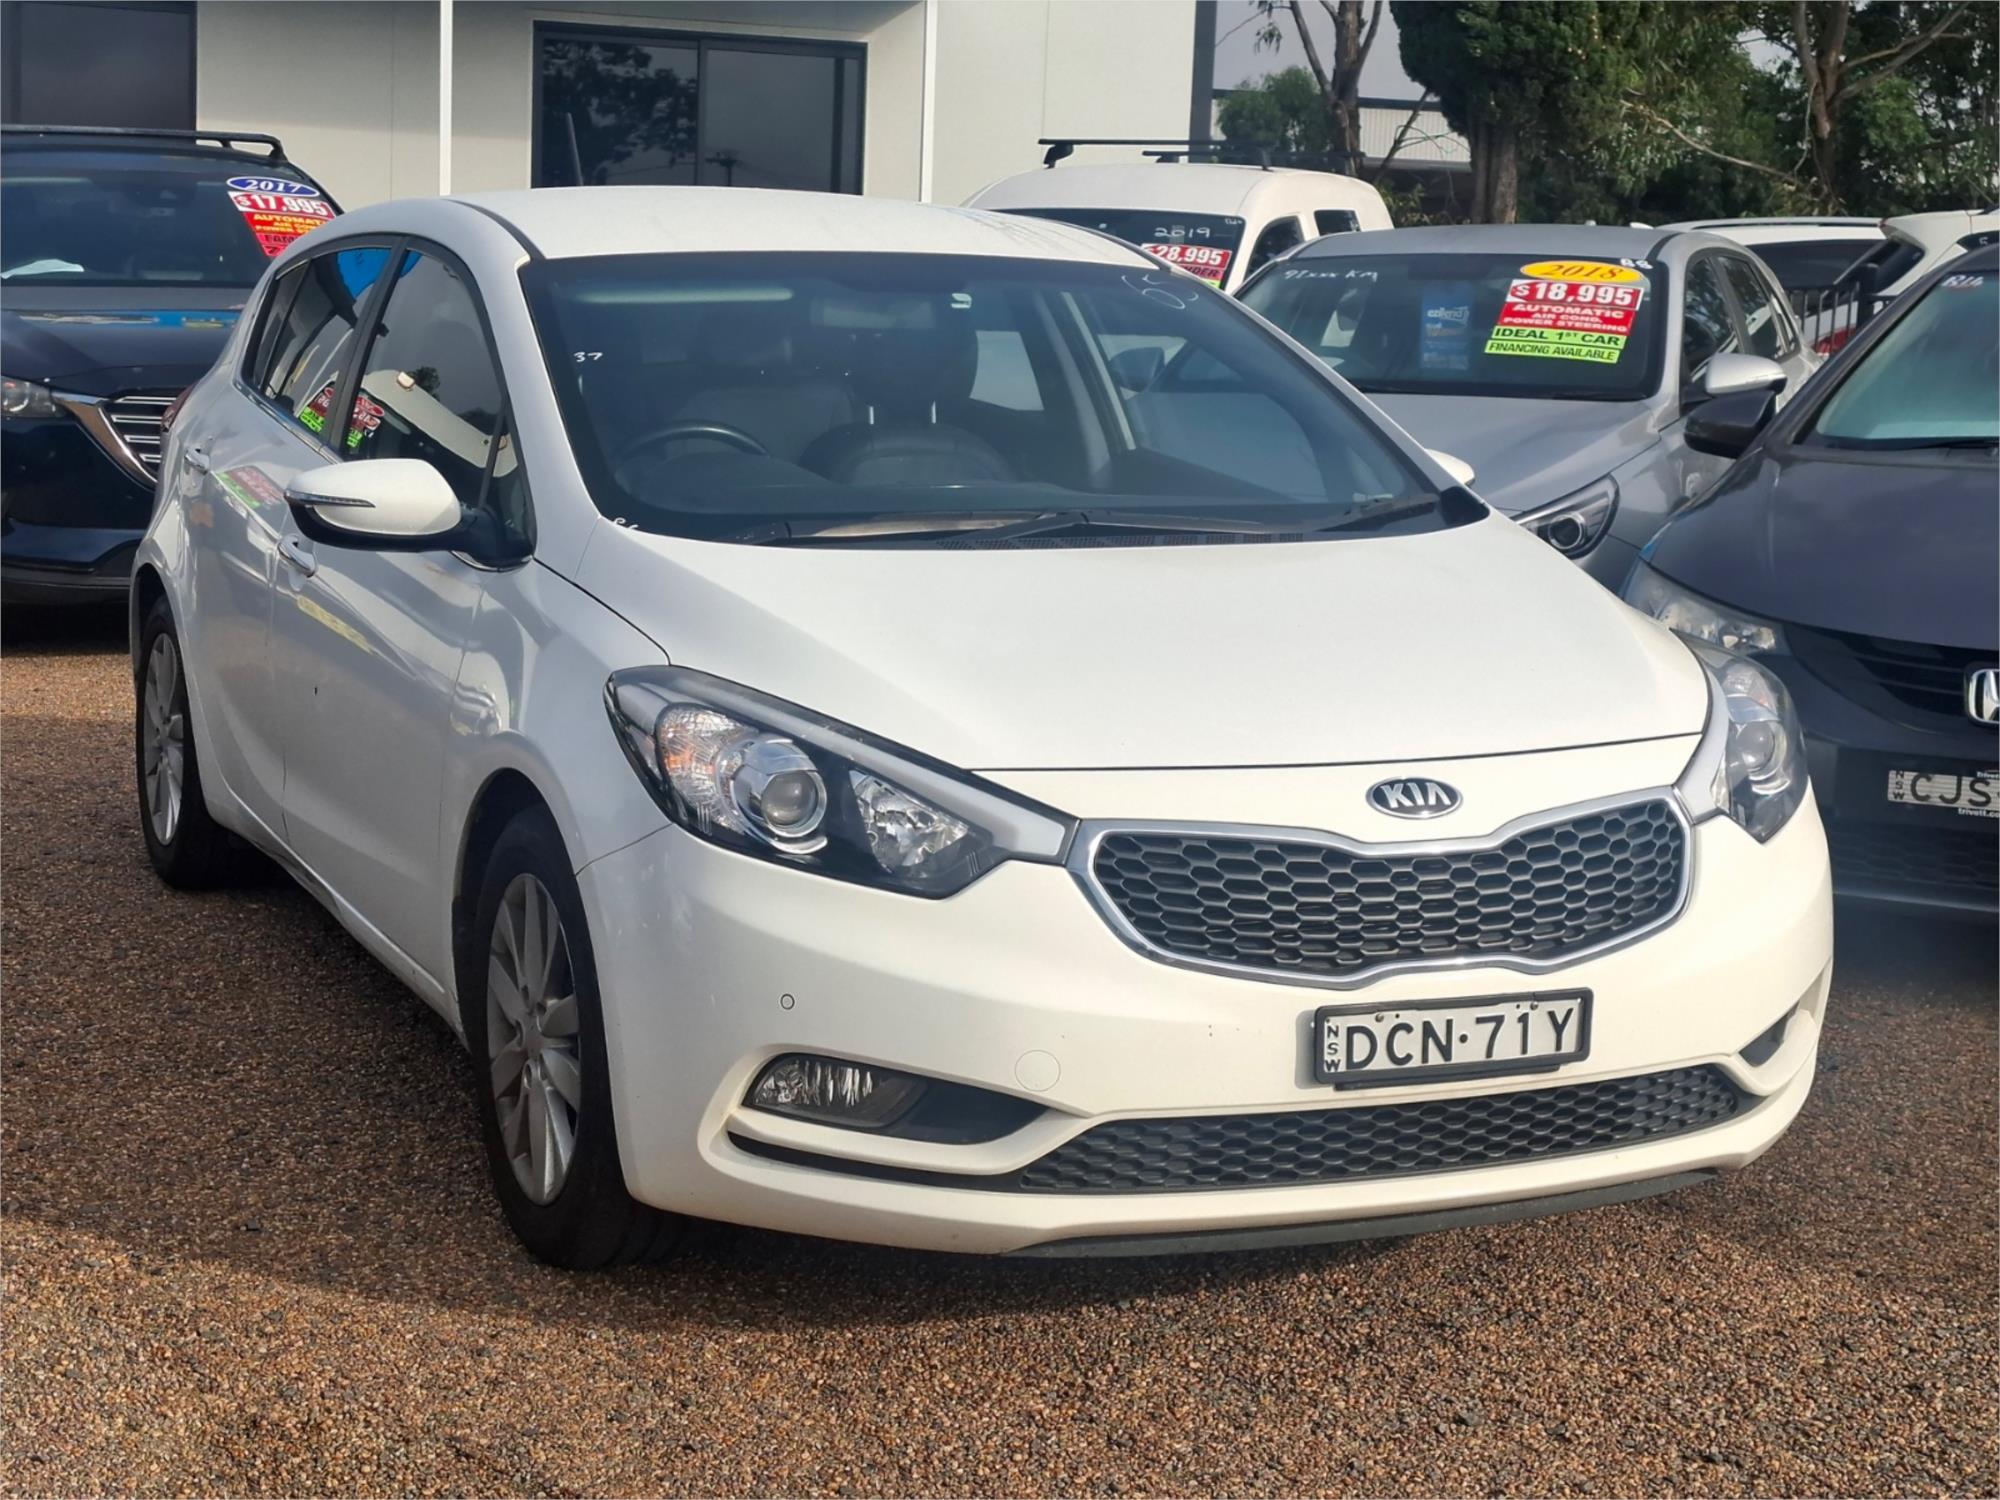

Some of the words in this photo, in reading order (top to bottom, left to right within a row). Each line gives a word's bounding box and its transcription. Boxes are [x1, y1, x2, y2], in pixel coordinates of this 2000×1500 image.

[245, 180, 301, 193] 2017
[1154, 227, 1211, 238] 2019
[1146, 245, 1224, 265] 28,995
[1541, 264, 1624, 279] 2018
[1516, 282, 1634, 306] $18,995
[1513, 304, 1625, 319] AUTOMATIC
[1504, 317, 1553, 326] POWER
[1556, 319, 1627, 332] STEERING
[1495, 328, 1548, 339] IDEAL
[1580, 334, 1620, 346] CAR
[1489, 343, 1549, 355] FINANCING
[1551, 345, 1616, 360] AVAILABLE
[1380, 782, 1451, 809] KIA
[1325, 1025, 1341, 1072] NSW
